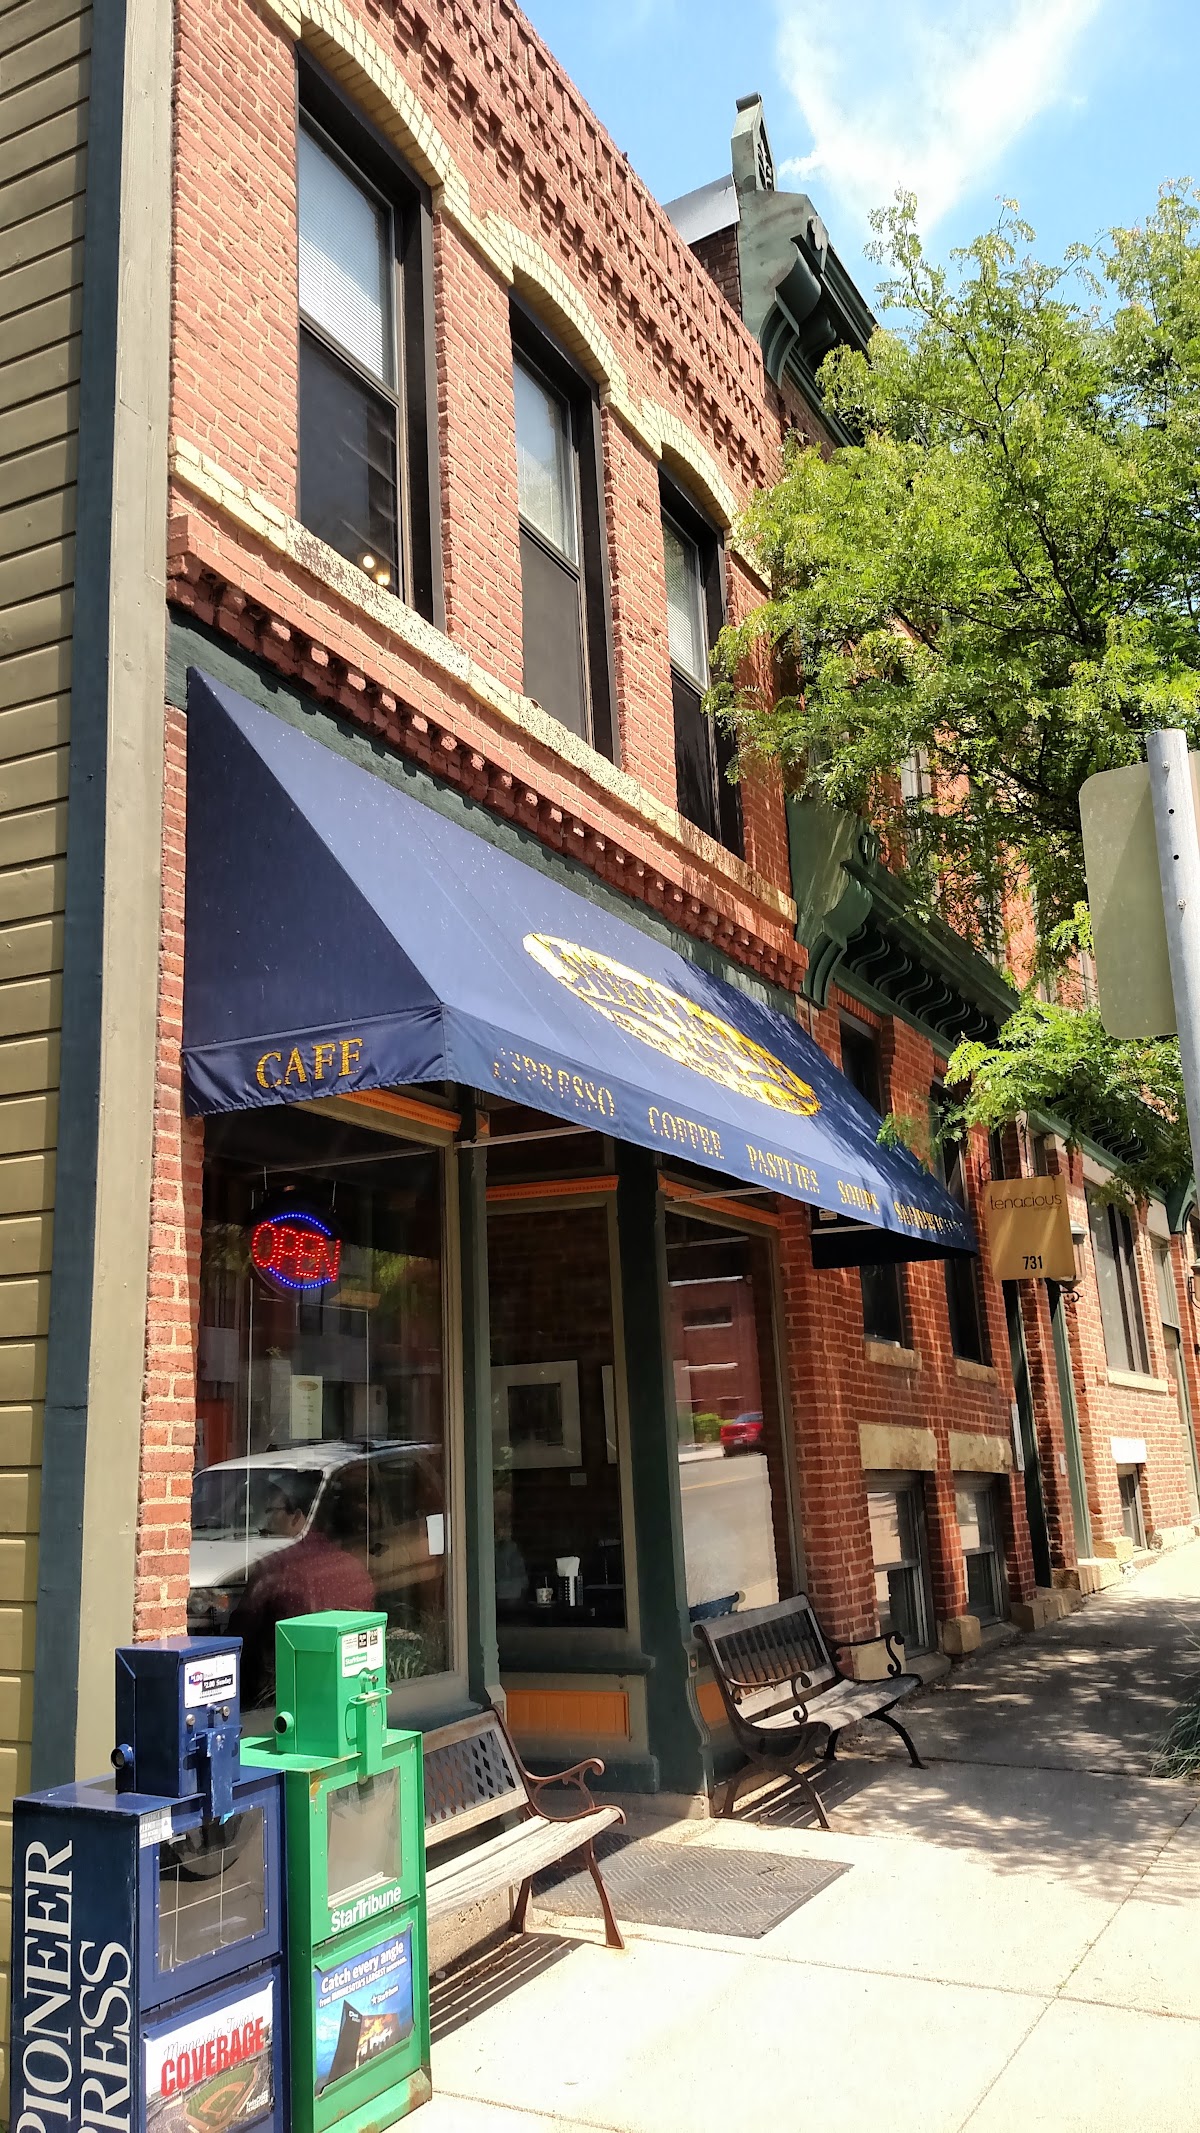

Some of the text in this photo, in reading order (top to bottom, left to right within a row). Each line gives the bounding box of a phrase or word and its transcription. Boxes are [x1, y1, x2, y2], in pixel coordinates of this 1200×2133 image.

[256, 1037, 364, 1089] CAFE
[648, 1106, 725, 1160] COFFEE
[746, 1144, 820, 1194] PASTRIES
[837, 1180, 881, 1215] SOUPS
[989, 1191, 1063, 1211] tenacious
[252, 1221, 342, 1283] OPEN
[1022, 1255, 1044, 1271] 731
[216, 1677, 232, 1687] Sunday
[331, 1886, 402, 1933] StarTribune
[321, 1966, 352, 1994] Catch
[352, 1953, 381, 1980] every
[380, 1940, 405, 1966] angle
[78, 1940, 132, 2133] RESS
[161, 2016, 265, 2097] COVERAGE
